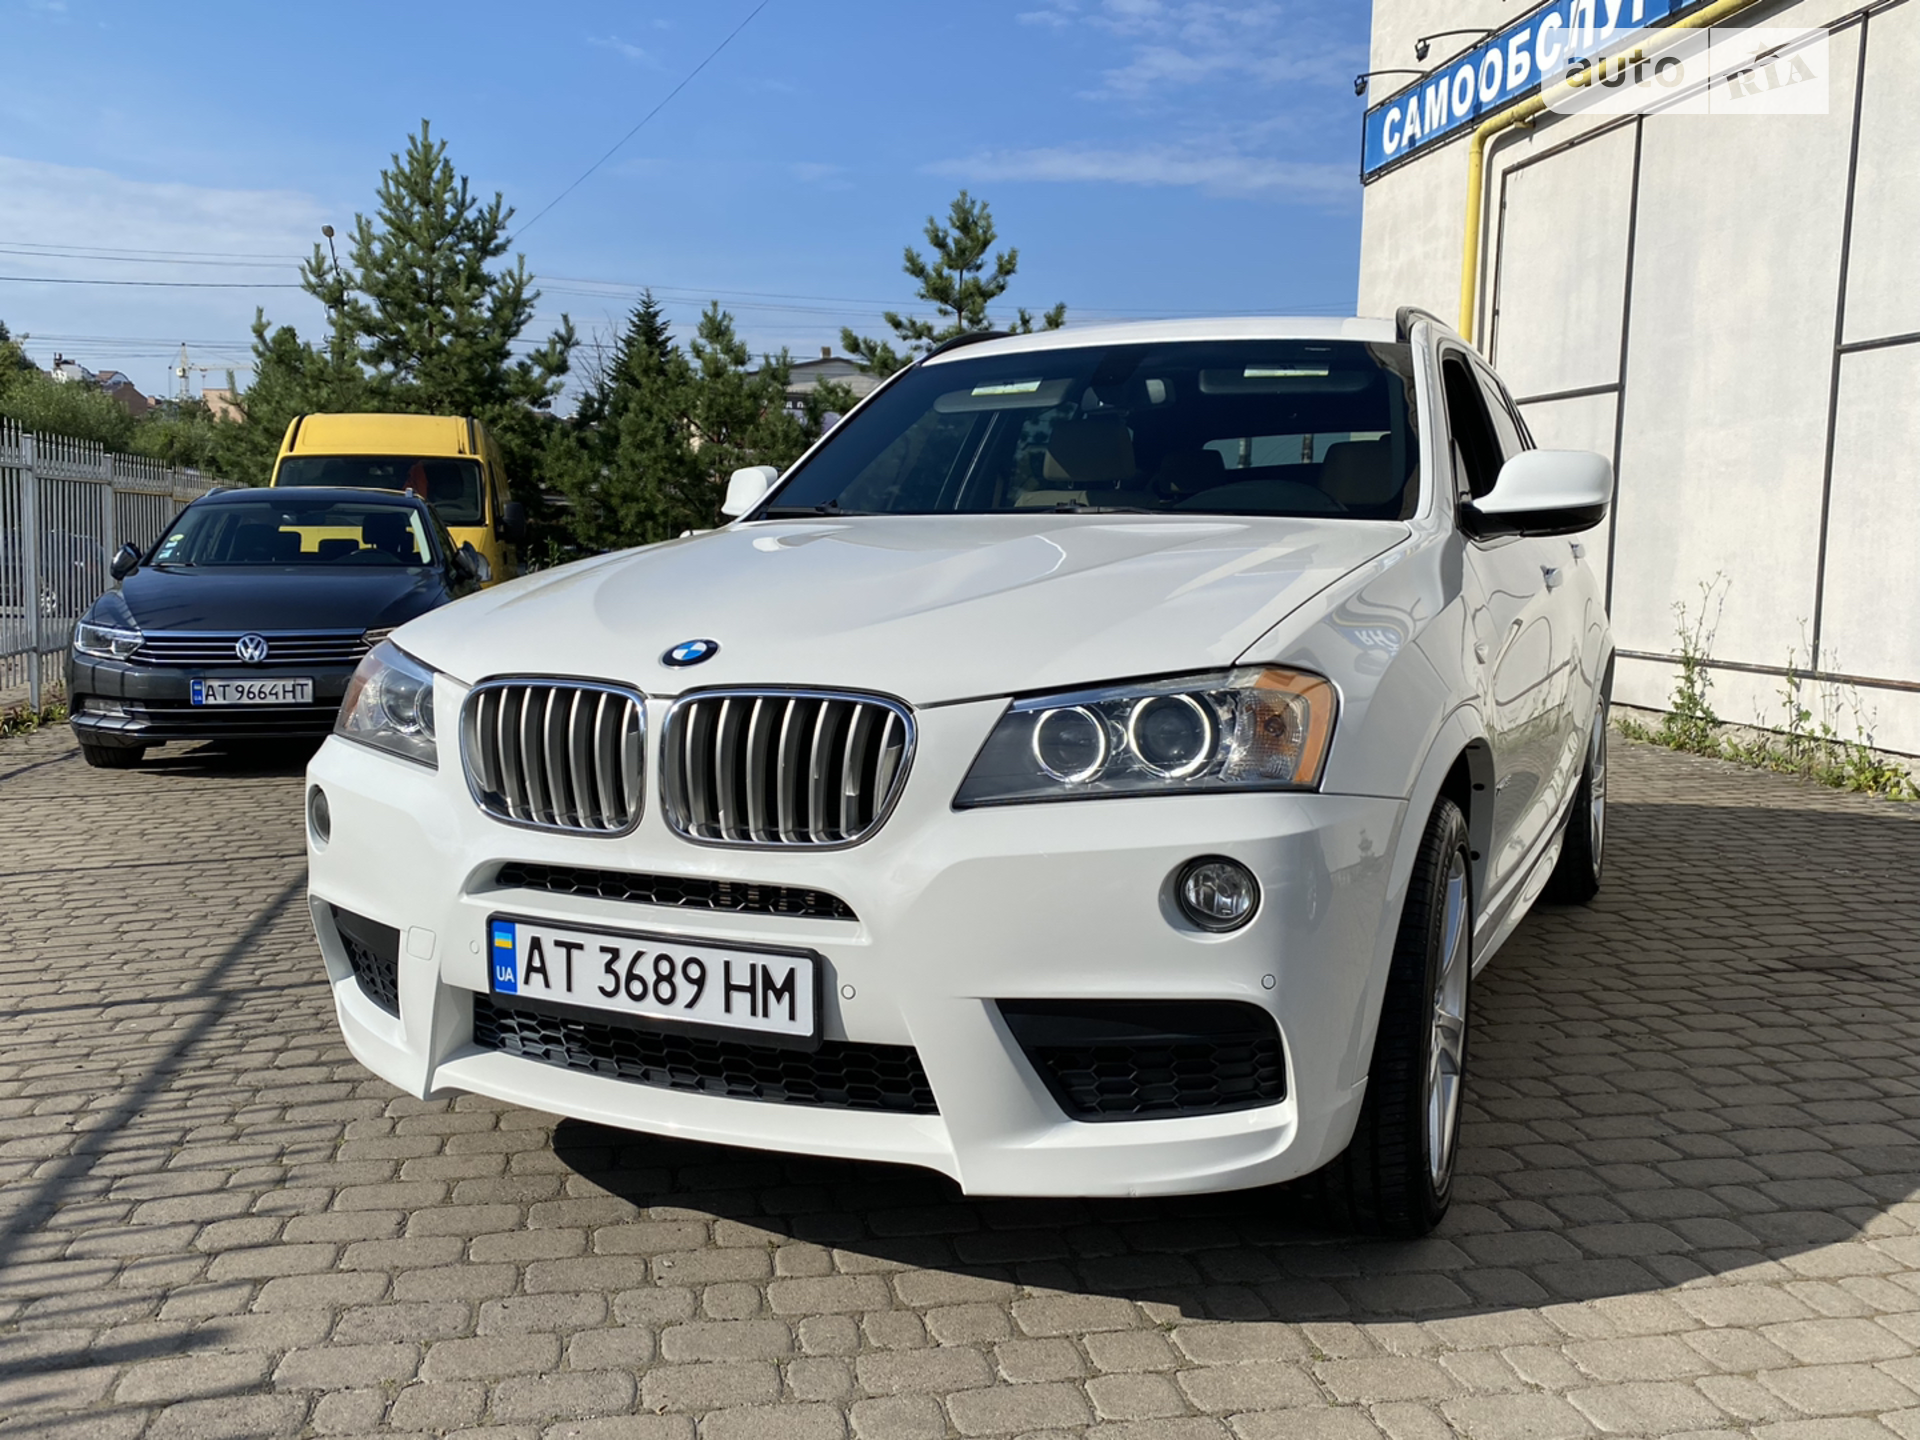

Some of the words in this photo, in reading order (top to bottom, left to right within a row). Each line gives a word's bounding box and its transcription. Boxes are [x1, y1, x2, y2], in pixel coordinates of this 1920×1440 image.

[205, 684, 230, 701] AT
[235, 684, 279, 701] 9664
[282, 683, 309, 700] HT
[496, 965, 515, 983] UA
[523, 935, 584, 993] AT
[597, 945, 706, 1009] 3689
[722, 959, 796, 1022] HM
